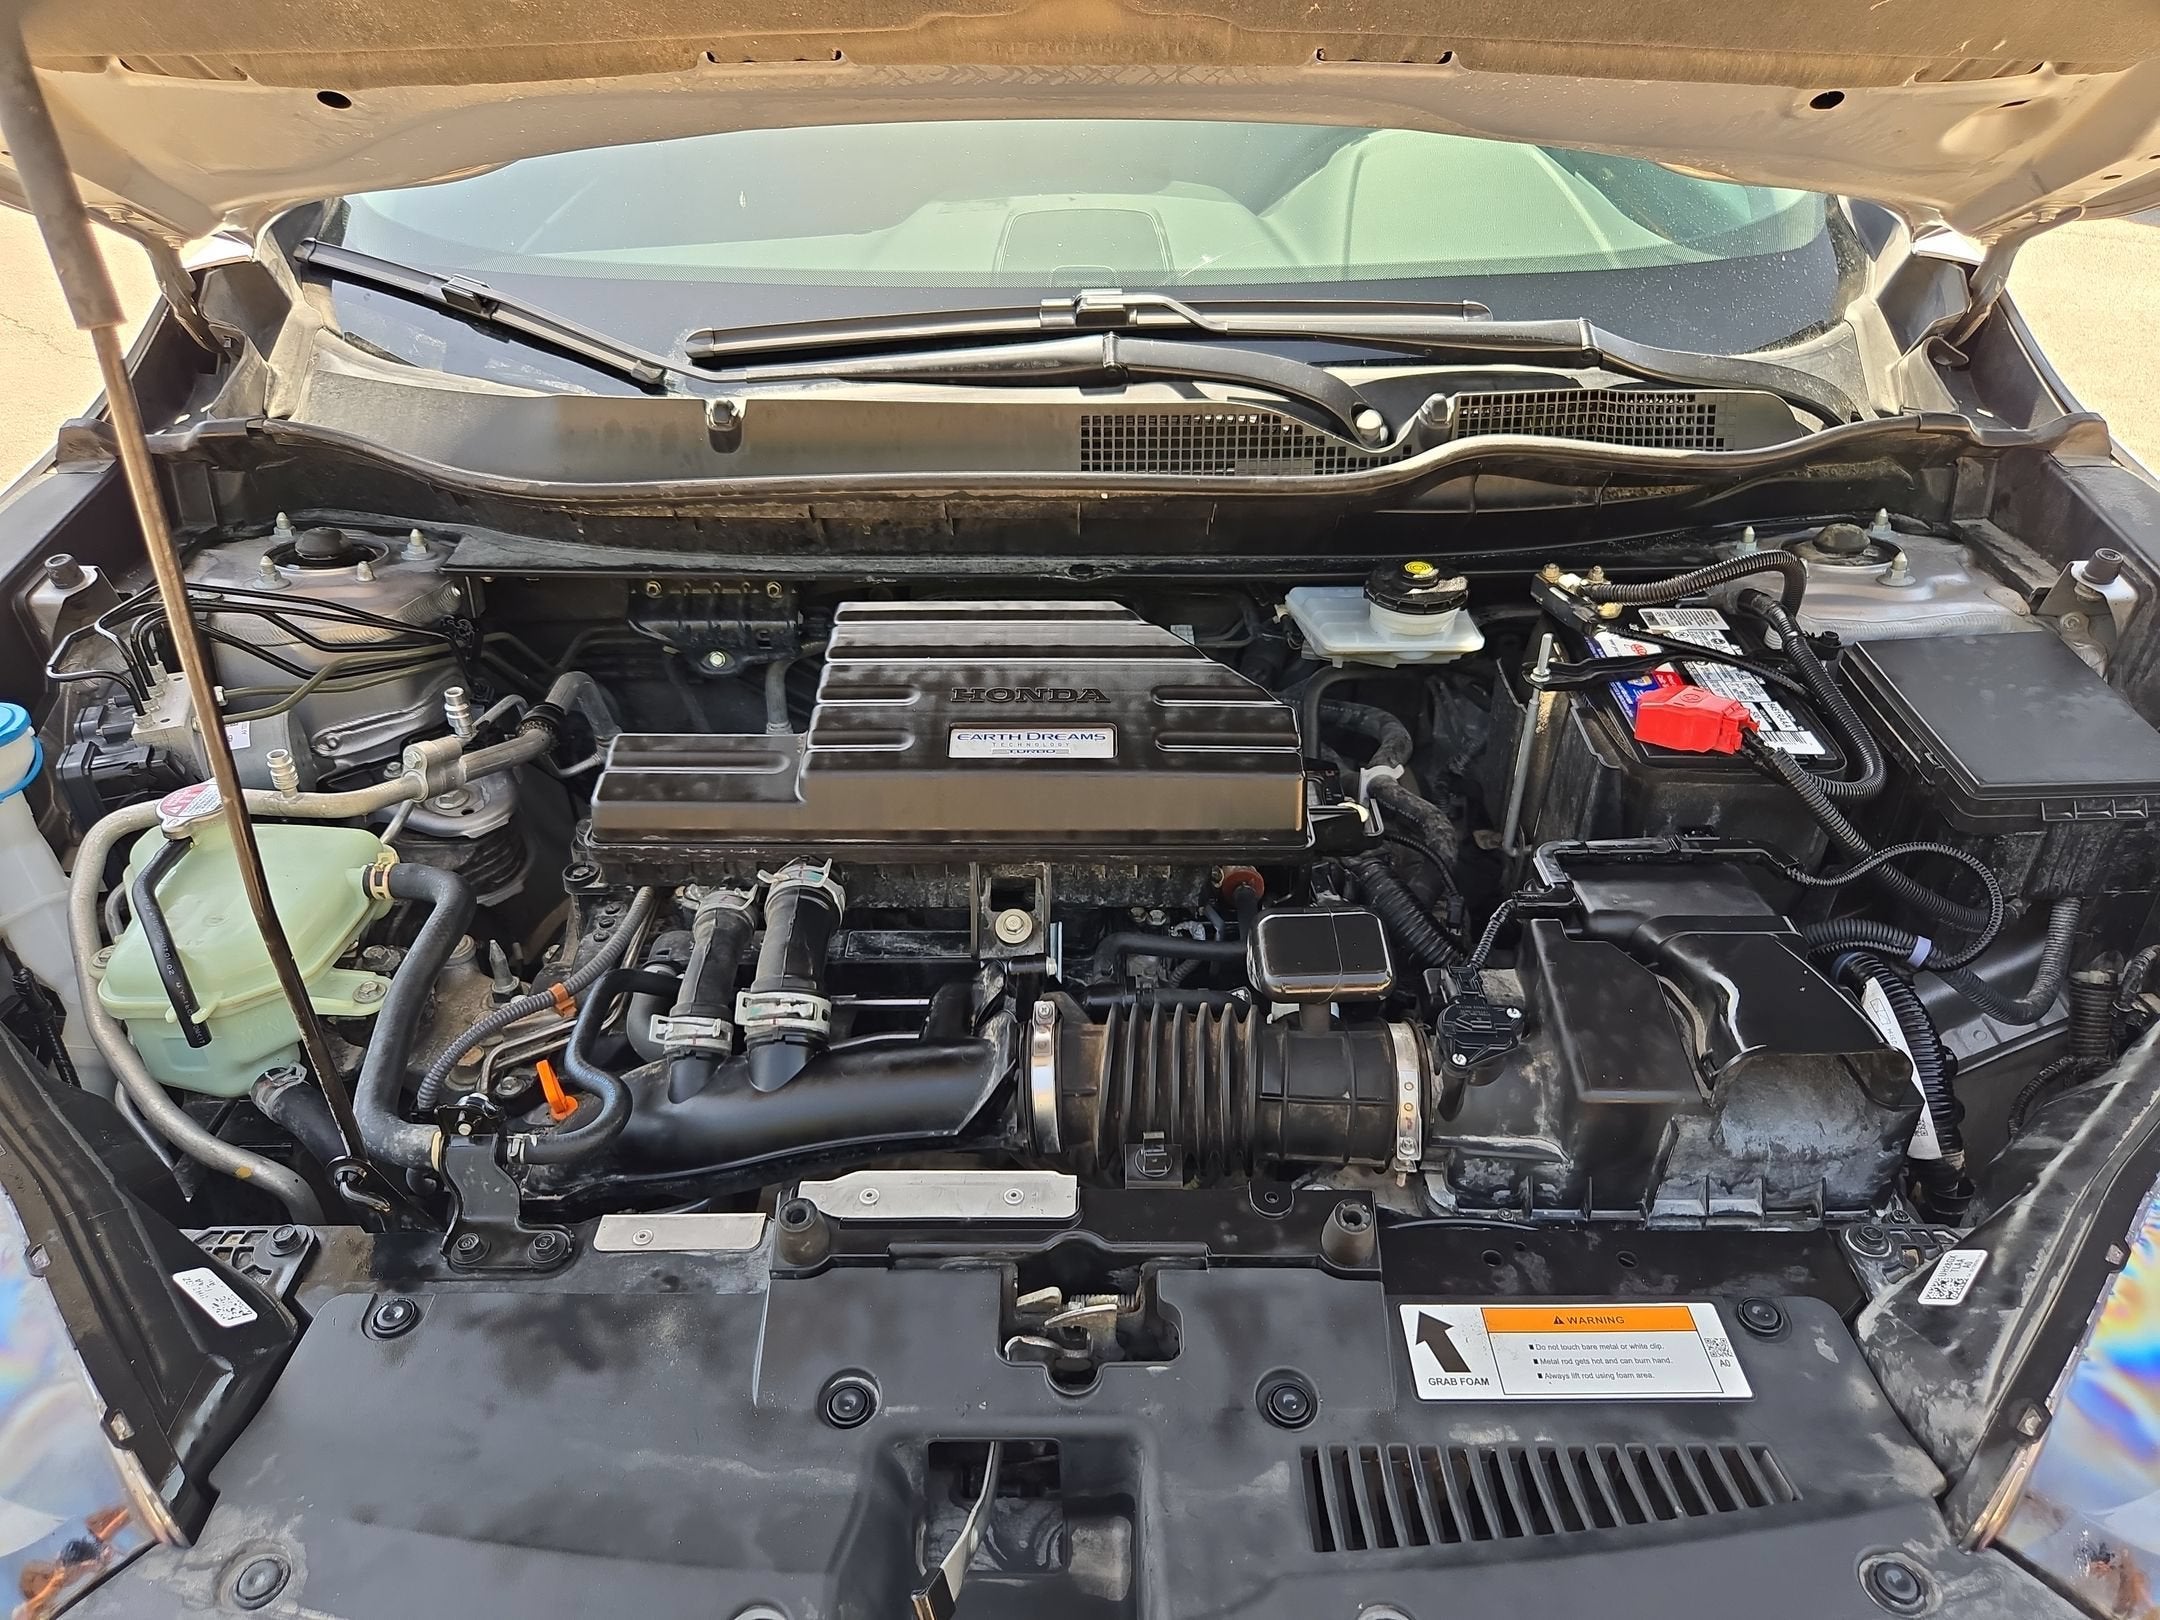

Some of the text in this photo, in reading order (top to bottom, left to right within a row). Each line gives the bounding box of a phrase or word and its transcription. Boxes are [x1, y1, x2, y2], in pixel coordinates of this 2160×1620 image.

[951, 686, 1111, 703] HONDA
[957, 731, 1106, 742] EARTH DREAMS
[1566, 1315, 1625, 1325] WARNING
[1574, 1358, 1591, 1366] gets
[1590, 1357, 1604, 1365] hot
[1544, 1372, 1570, 1381] Always
[1570, 1372, 1581, 1380] lift
[1594, 1371, 1615, 1381] using
[1615, 1371, 1635, 1379] foam
[1635, 1371, 1656, 1379] area.
[1428, 1377, 1490, 1386] GRAB FOAM
